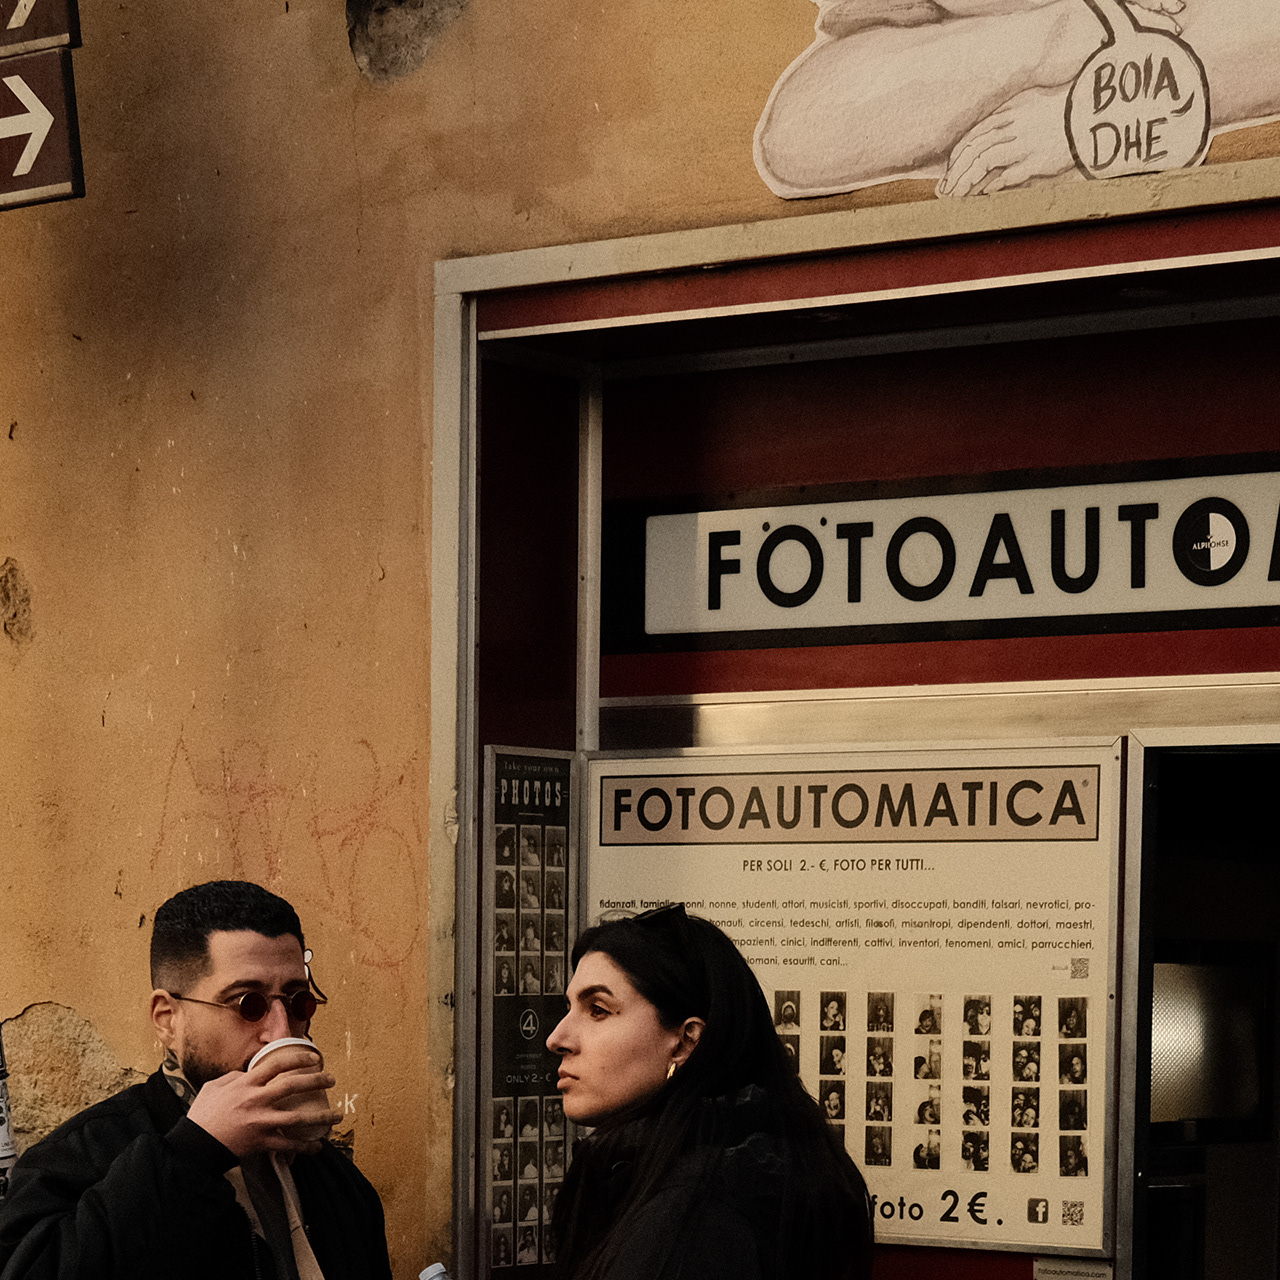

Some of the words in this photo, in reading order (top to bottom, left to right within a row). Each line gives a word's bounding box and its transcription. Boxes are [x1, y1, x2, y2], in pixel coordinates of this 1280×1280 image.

[1192, 538, 1230, 551] ALPHONSE
[500, 778, 562, 808] PHOTOS
[742, 859, 763, 872] PER
[766, 859, 793, 872] SOLI
[834, 858, 867, 872] FOTO
[871, 858, 892, 872] PER
[599, 899, 638, 910] fidanzati,
[709, 899, 738, 910] nonne,
[741, 899, 779, 910] studenti,
[782, 899, 805, 910] attori,
[810, 899, 851, 910] musicisti,
[854, 899, 889, 910] sportivi,
[891, 899, 950, 910] disoccupati,
[953, 899, 989, 910] banditi,
[1026, 899, 1071, 910] nevrotici,
[1075, 900, 1096, 911] pro-
[749, 918, 786, 929] circensi,
[790, 918, 830, 929] tedeschi,
[835, 918, 862, 929] artisti,
[866, 918, 897, 929] filosofi,
[901, 919, 953, 930] misantropi,
[958, 919, 1013, 930] dipendenti,
[1017, 919, 1051, 930] dottori,
[1056, 919, 1095, 930] maestri,
[780, 936, 807, 948] cinici,
[810, 936, 861, 948] indifferenti,
[864, 936, 895, 948] cattivi,
[899, 937, 941, 949] inventori,
[945, 937, 994, 949] fenomeni,
[997, 937, 1028, 949] amici,
[1031, 938, 1095, 950] parrucchieri,
[783, 956, 817, 967] esauriti,
[522, 1014, 536, 1035] 4
[505, 1074, 529, 1084] ONLY
[871, 1194, 925, 1222] foto
